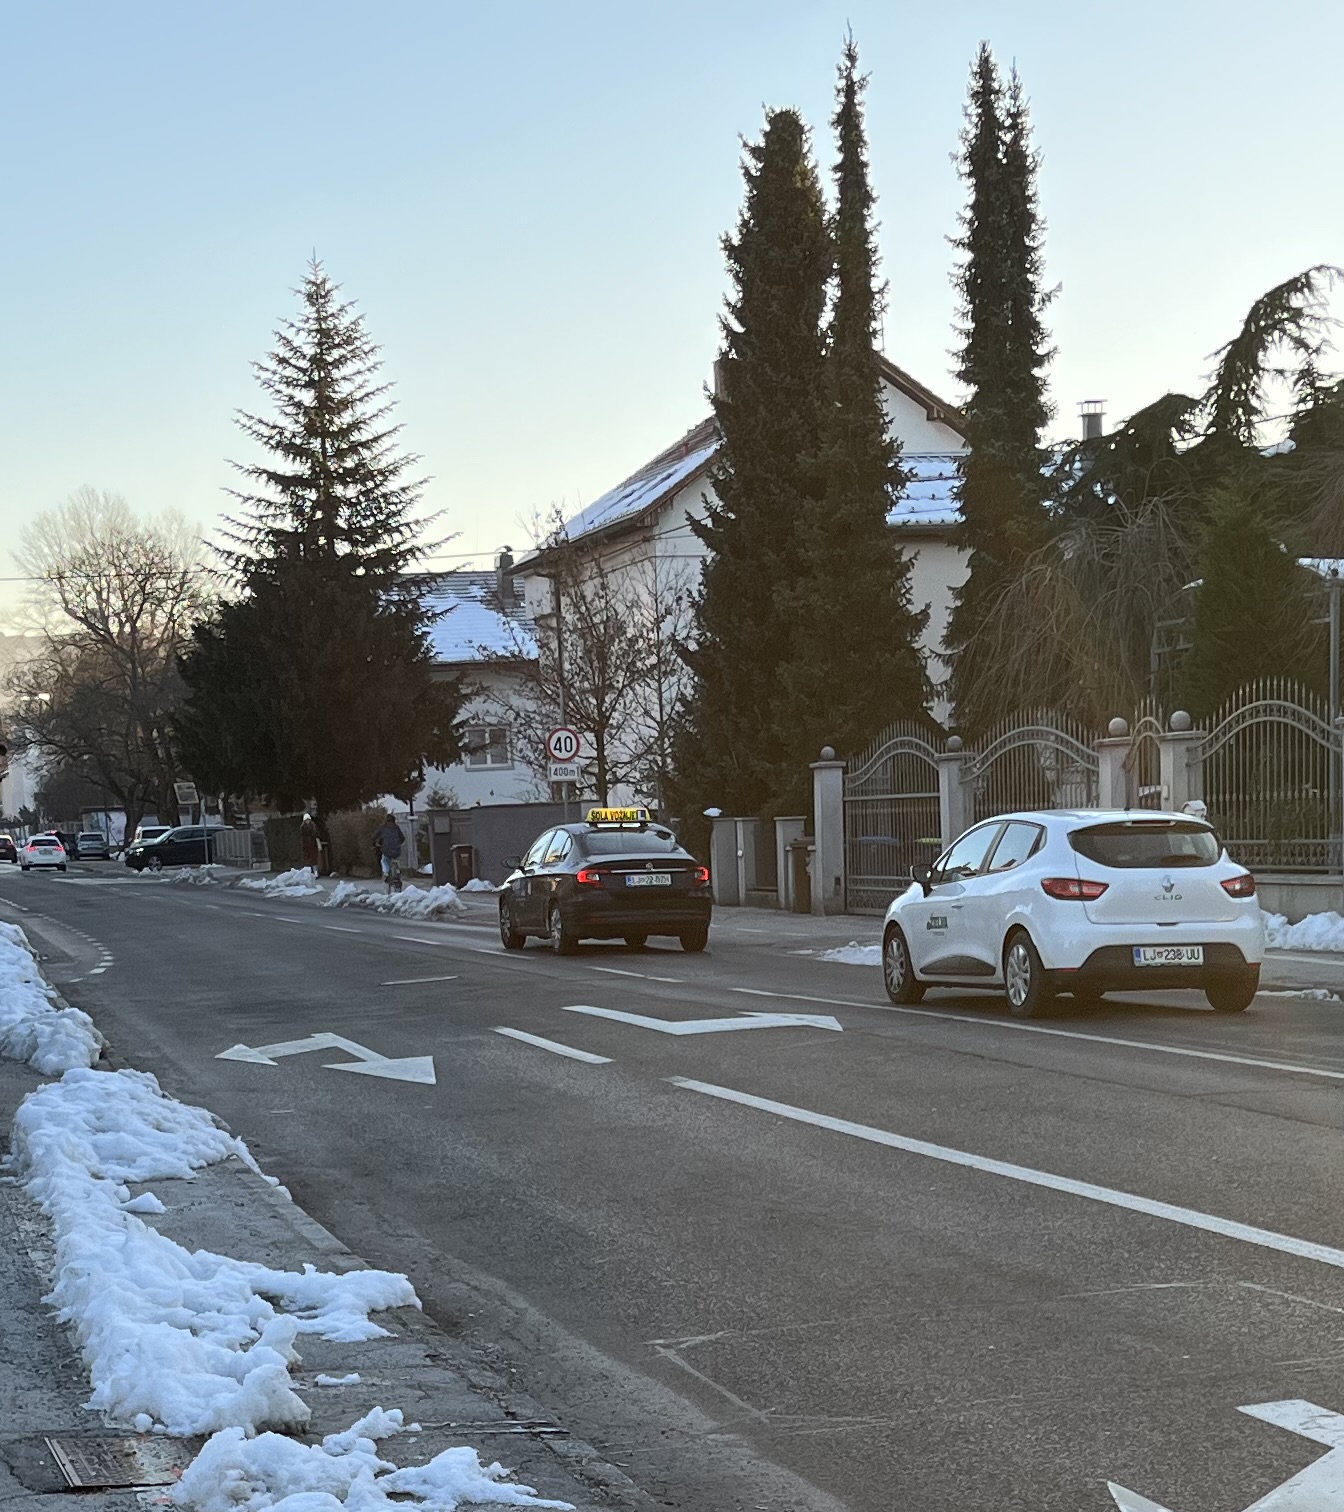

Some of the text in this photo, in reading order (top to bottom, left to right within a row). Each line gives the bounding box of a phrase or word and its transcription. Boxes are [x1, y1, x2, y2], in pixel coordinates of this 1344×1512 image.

[553, 735, 573, 754] 40
[553, 766, 576, 777] 400m
[591, 810, 609, 821] ŠOLA
[1142, 949, 1157, 962] LJ
